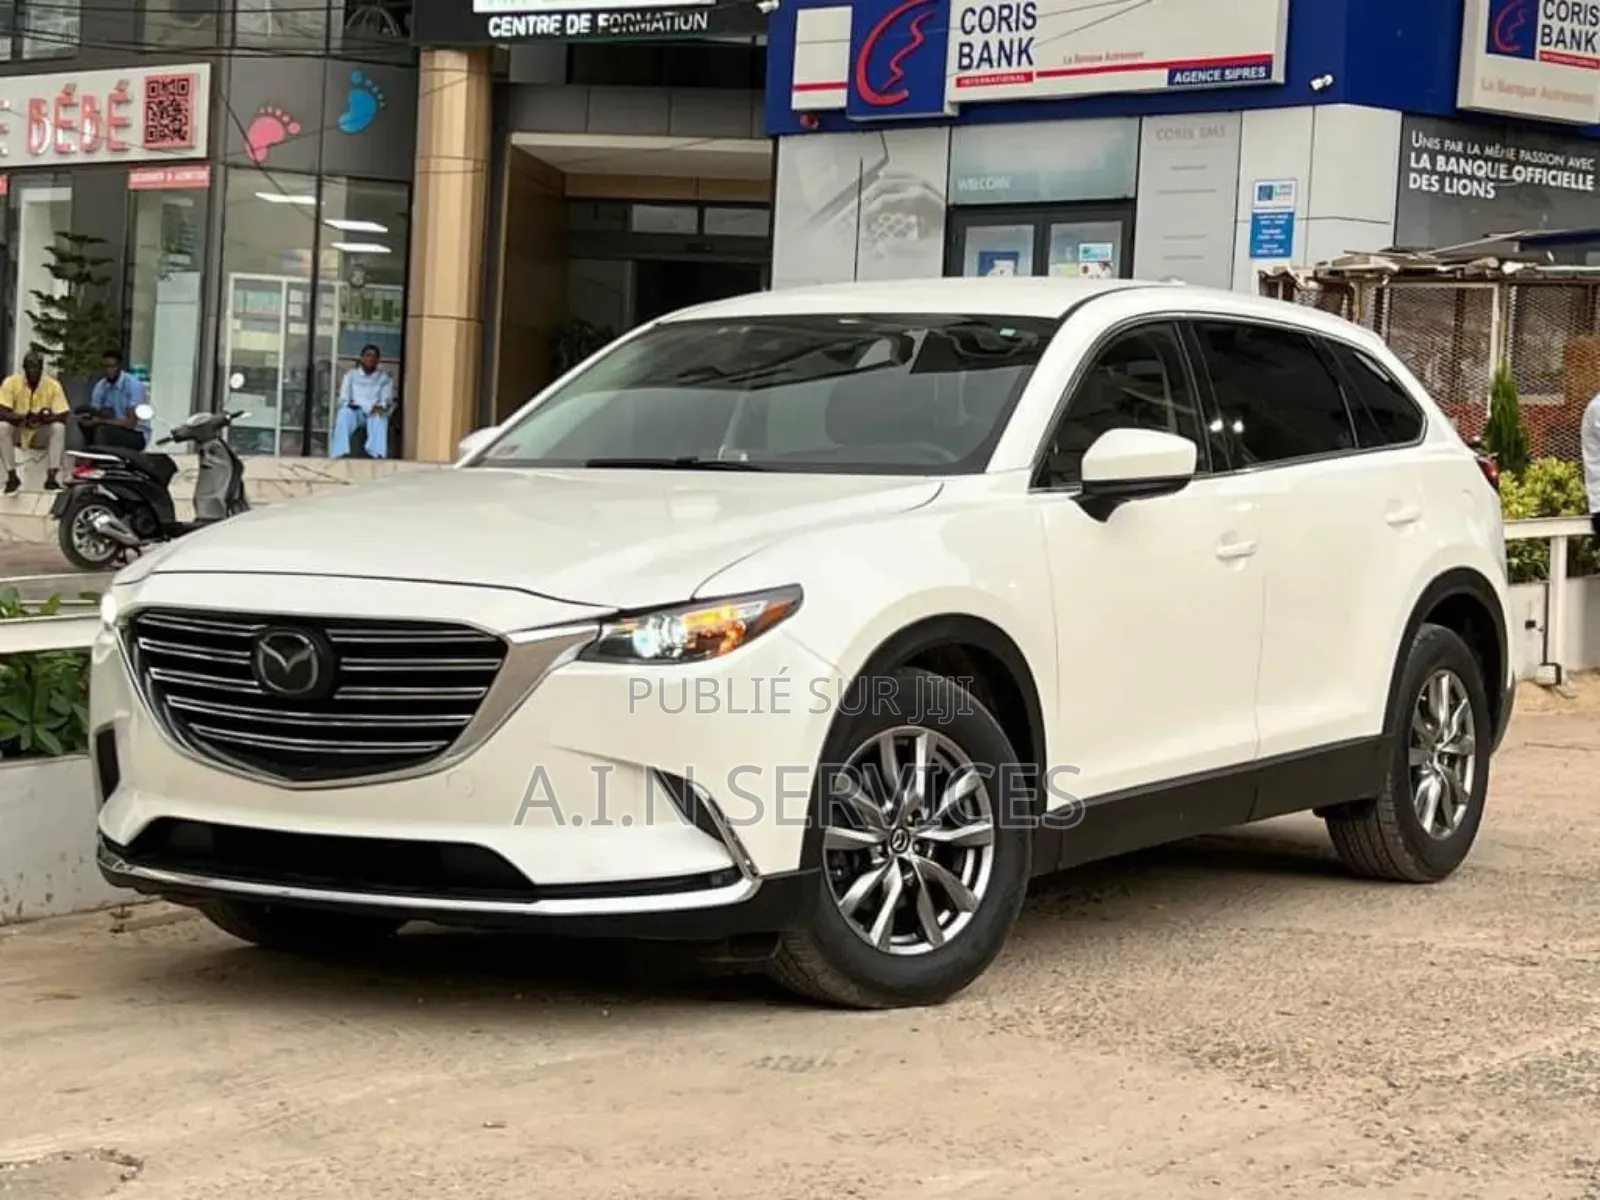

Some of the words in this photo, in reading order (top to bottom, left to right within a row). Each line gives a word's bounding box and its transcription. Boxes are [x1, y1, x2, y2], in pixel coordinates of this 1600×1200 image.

[488, 14, 562, 37] CENTRE
[566, 13, 593, 34] DE
[598, 11, 708, 33] FORMATION
[960, 2, 1037, 35] CORIS
[1543, 0, 1600, 27] CORIS
[958, 37, 1035, 71] BANK
[1540, 24, 1597, 54] BANK
[1174, 68, 1221, 83] AGENCE
[1224, 65, 1266, 79] SIPRES
[27, 77, 131, 155] BÉBÉ
[1444, 140, 1464, 154] PAR
[1467, 143, 1481, 156] LA
[1519, 149, 1564, 168] PASSION
[1567, 157, 1596, 171] AVEC
[1408, 172, 1440, 193] DES
[1444, 175, 1496, 200] LIONS
[1410, 151, 1431, 171] LA
[1436, 154, 1509, 180] BANQUE
[1512, 164, 1595, 192] OFFICIELLE
